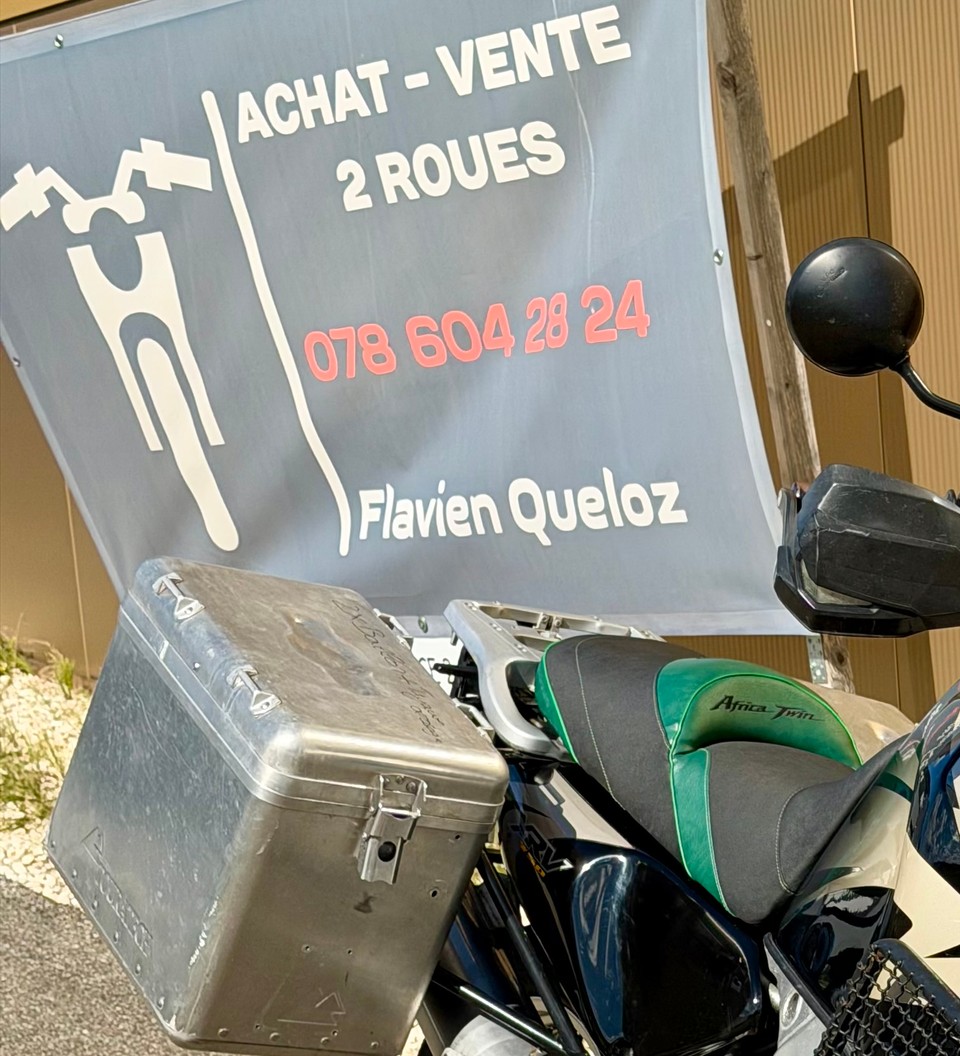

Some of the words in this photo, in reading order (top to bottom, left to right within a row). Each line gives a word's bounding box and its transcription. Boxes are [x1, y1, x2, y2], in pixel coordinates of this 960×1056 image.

[238, 59, 390, 144] ACHAT
[435, 4, 632, 96] VENTE
[336, 159, 373, 212] 2
[375, 120, 566, 204] ROUES
[303, 323, 397, 382] 078
[404, 303, 515, 369] 604
[524, 293, 568, 353] 28
[580, 280, 650, 344] 24
[358, 479, 503, 540] Flavien
[508, 466, 689, 546] Queloz
[710, 694, 772, 713] Africa
[771, 704, 822, 721] Twin
